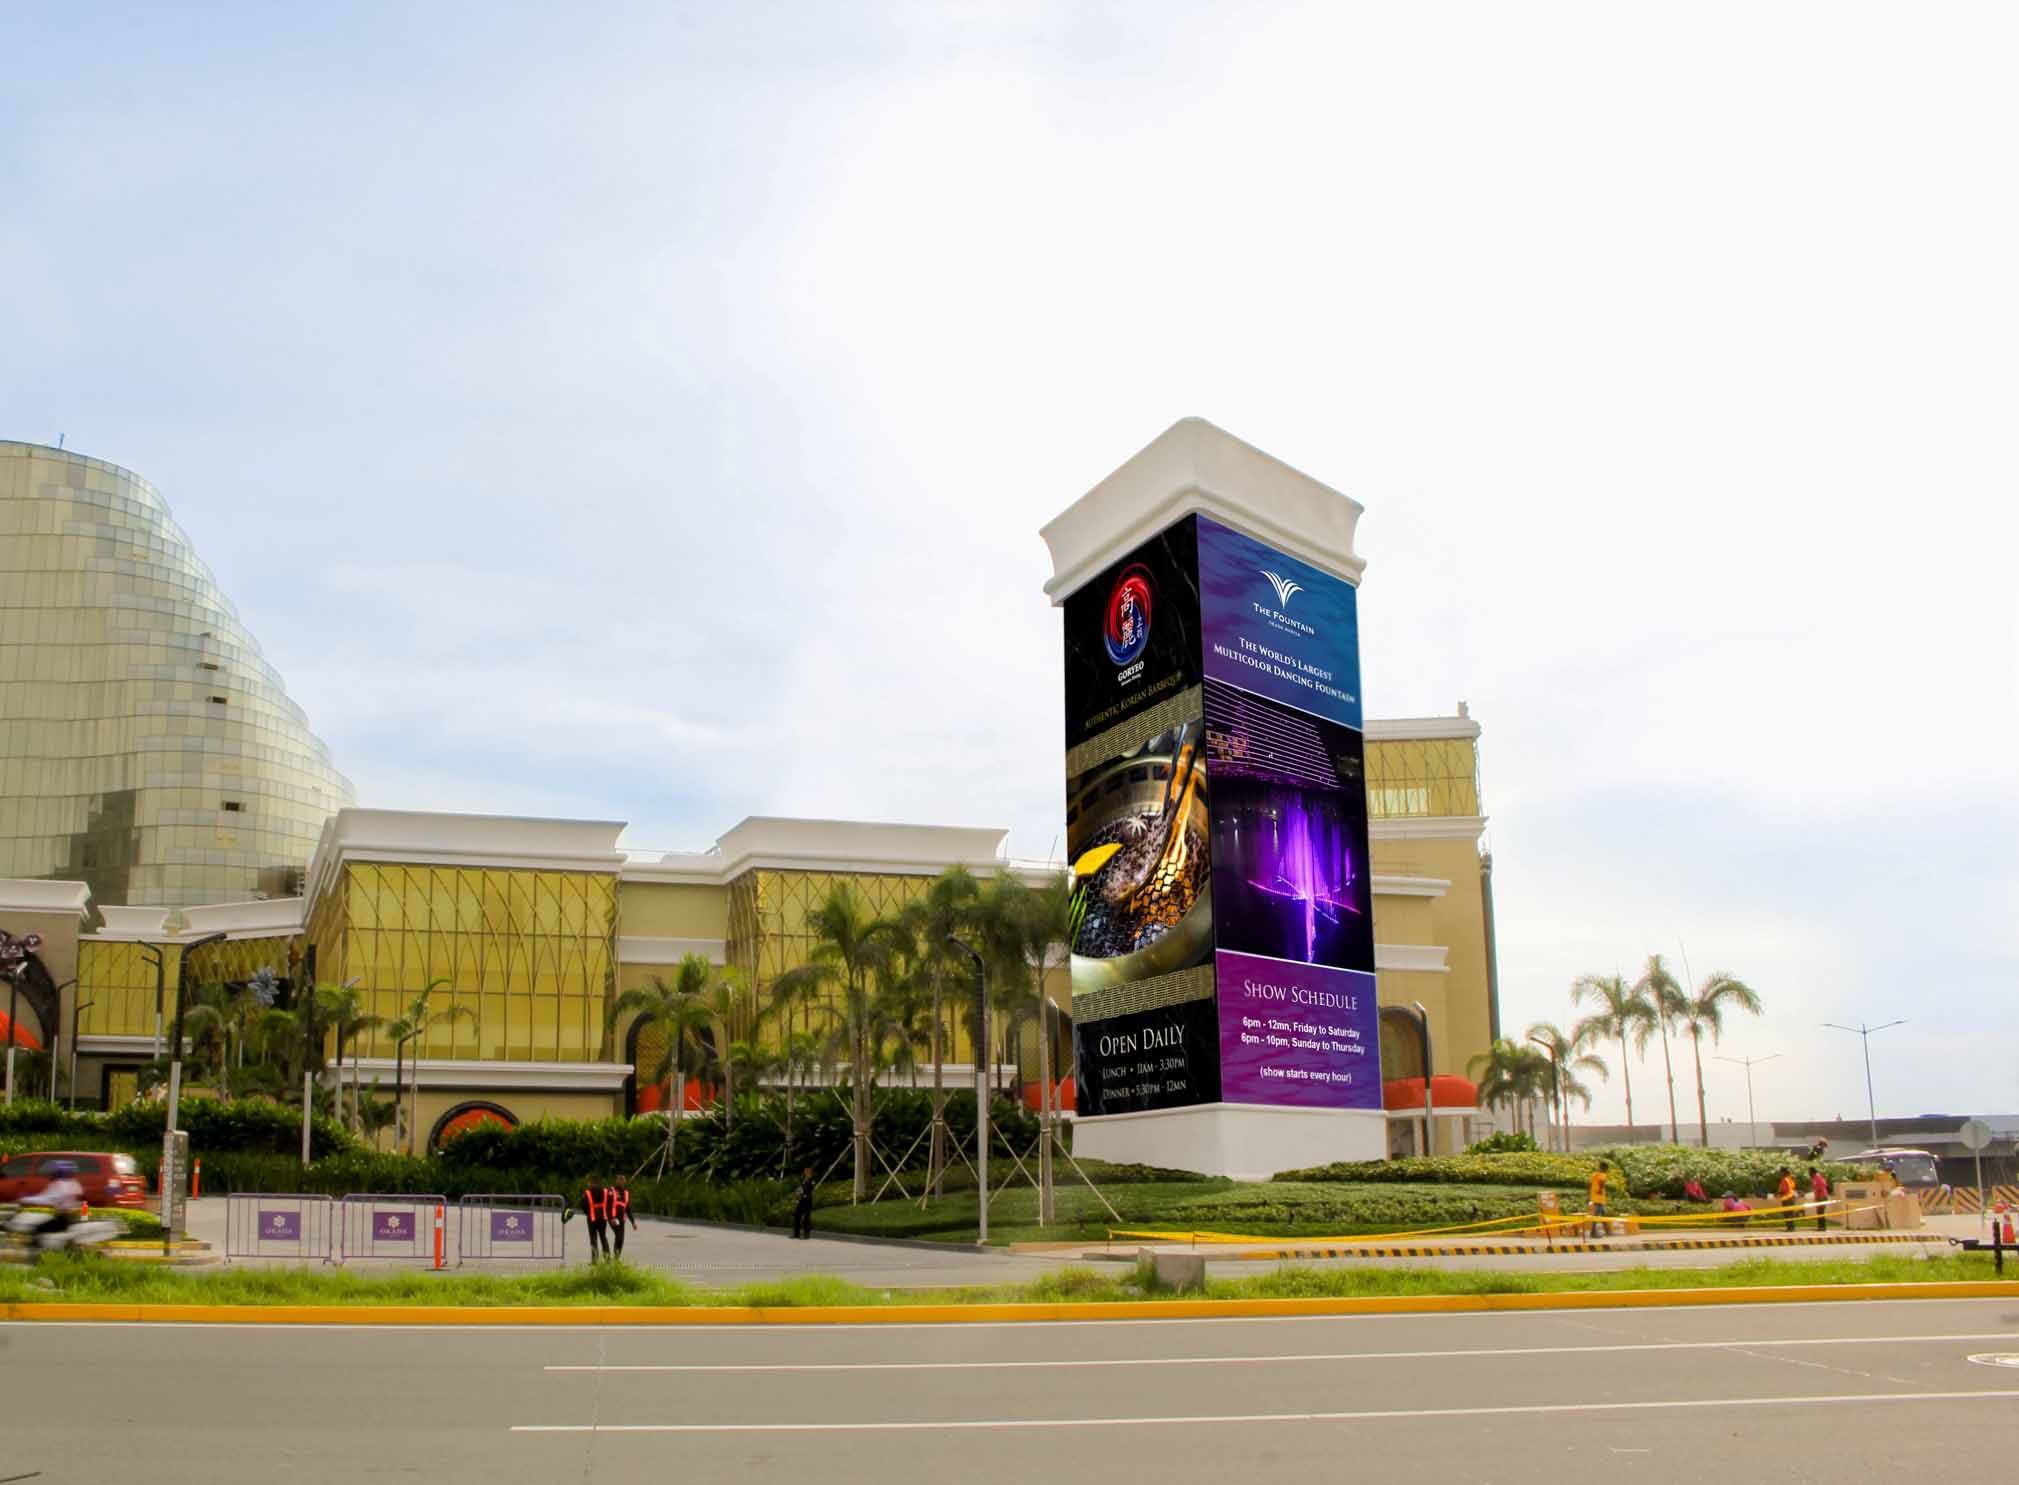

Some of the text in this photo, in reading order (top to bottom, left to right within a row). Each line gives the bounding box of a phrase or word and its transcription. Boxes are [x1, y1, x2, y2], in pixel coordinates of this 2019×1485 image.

[1273, 611, 1315, 636] FOUNTAIN
[1118, 660, 1145, 682] GORYEO
[1213, 643, 1272, 673] MULTICOLOR
[1274, 665, 1313, 689] DANCING
[1243, 979, 1358, 1011] SHOW SCHEDULE
[1099, 1023, 1185, 1057] OPEN DAILY
[1242, 1016, 1261, 1029] 6pm
[1268, 1019, 1292, 1033] 12mn,
[1293, 1022, 1318, 1036] Friday
[1318, 1025, 1327, 1035] to
[1328, 1026, 1361, 1041] Saturday
[1241, 1032, 1260, 1045] 6pm
[1292, 1037, 1321, 1052] Sunday
[1322, 1040, 1330, 1050] to
[1331, 1041, 1365, 1056] Thursday
[1102, 1065, 1127, 1080] LUNCH
[1260, 1066, 1352, 1084] (show starts every hour)
